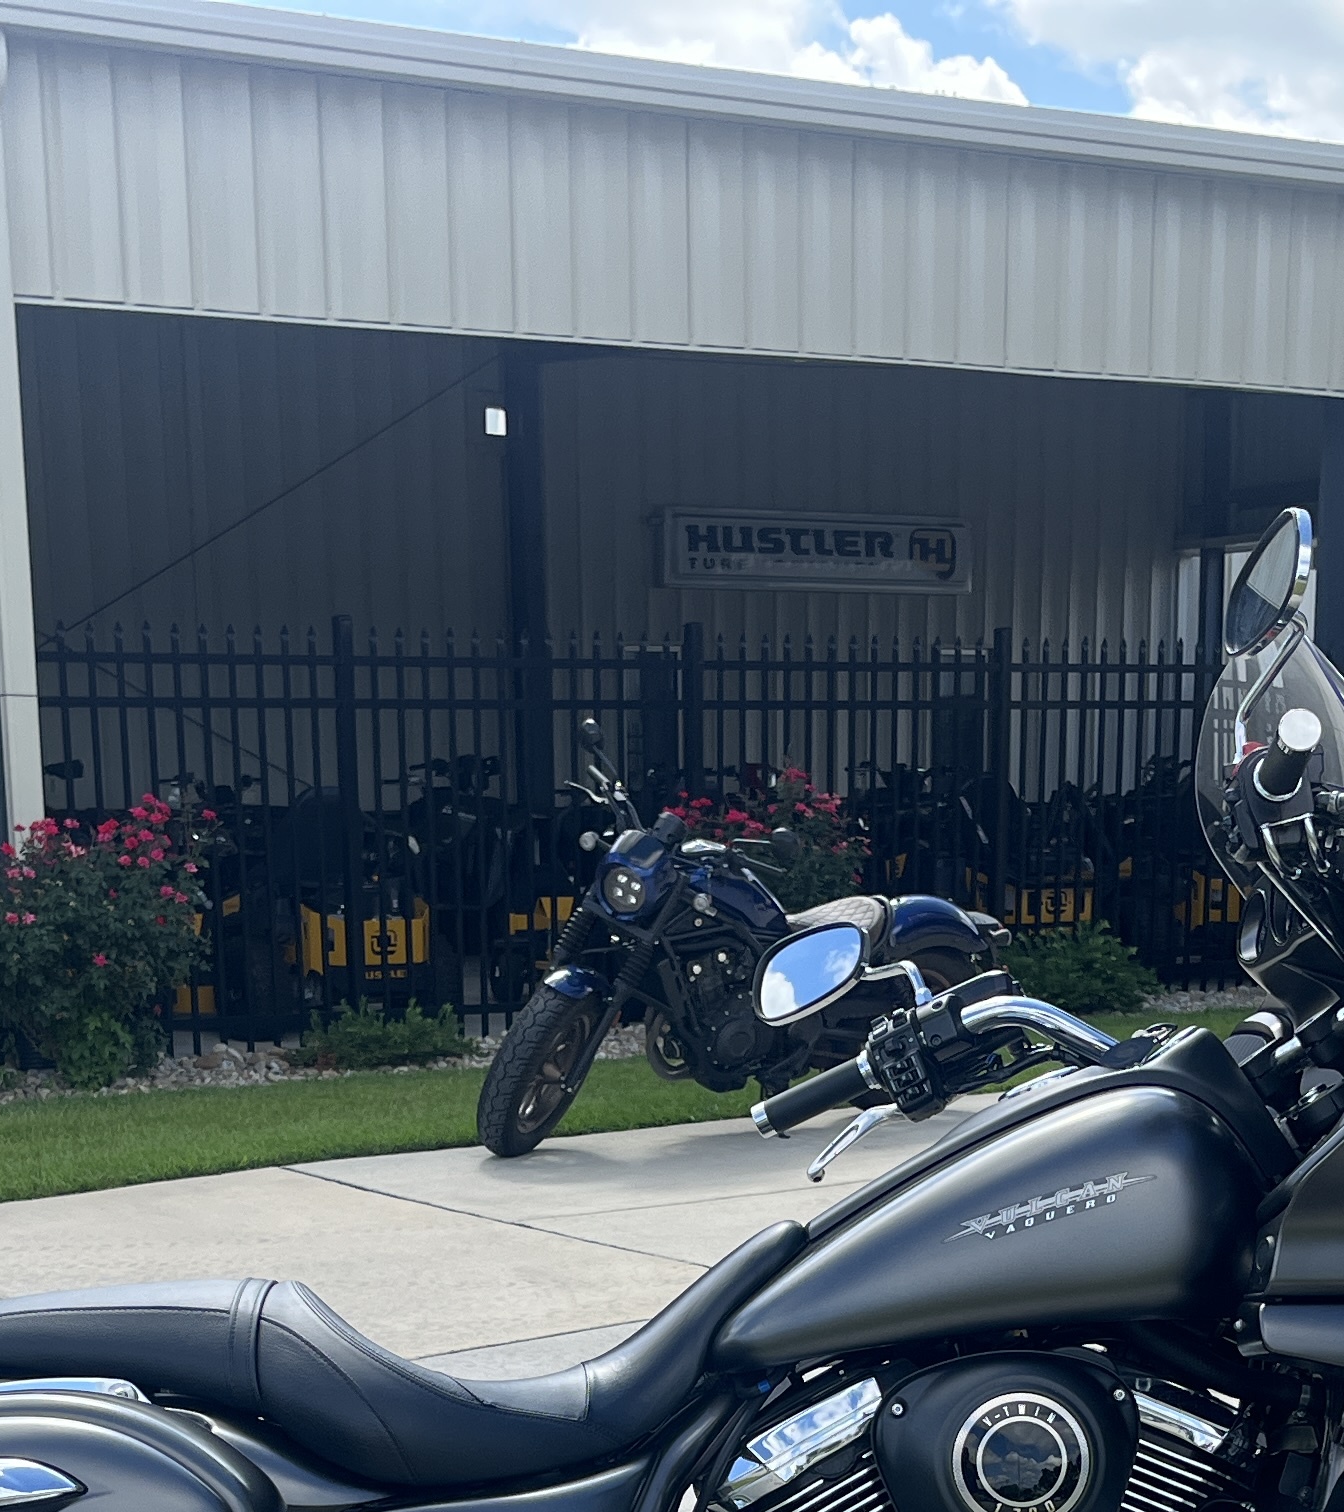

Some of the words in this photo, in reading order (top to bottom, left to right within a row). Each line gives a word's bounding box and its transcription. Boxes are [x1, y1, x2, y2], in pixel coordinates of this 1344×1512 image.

[685, 524, 895, 559] HUSTLER
[960, 1171, 1129, 1235] VULCAN
[984, 1193, 1117, 1240] VAQUERO
[981, 1403, 1057, 1427] V-TWIN
